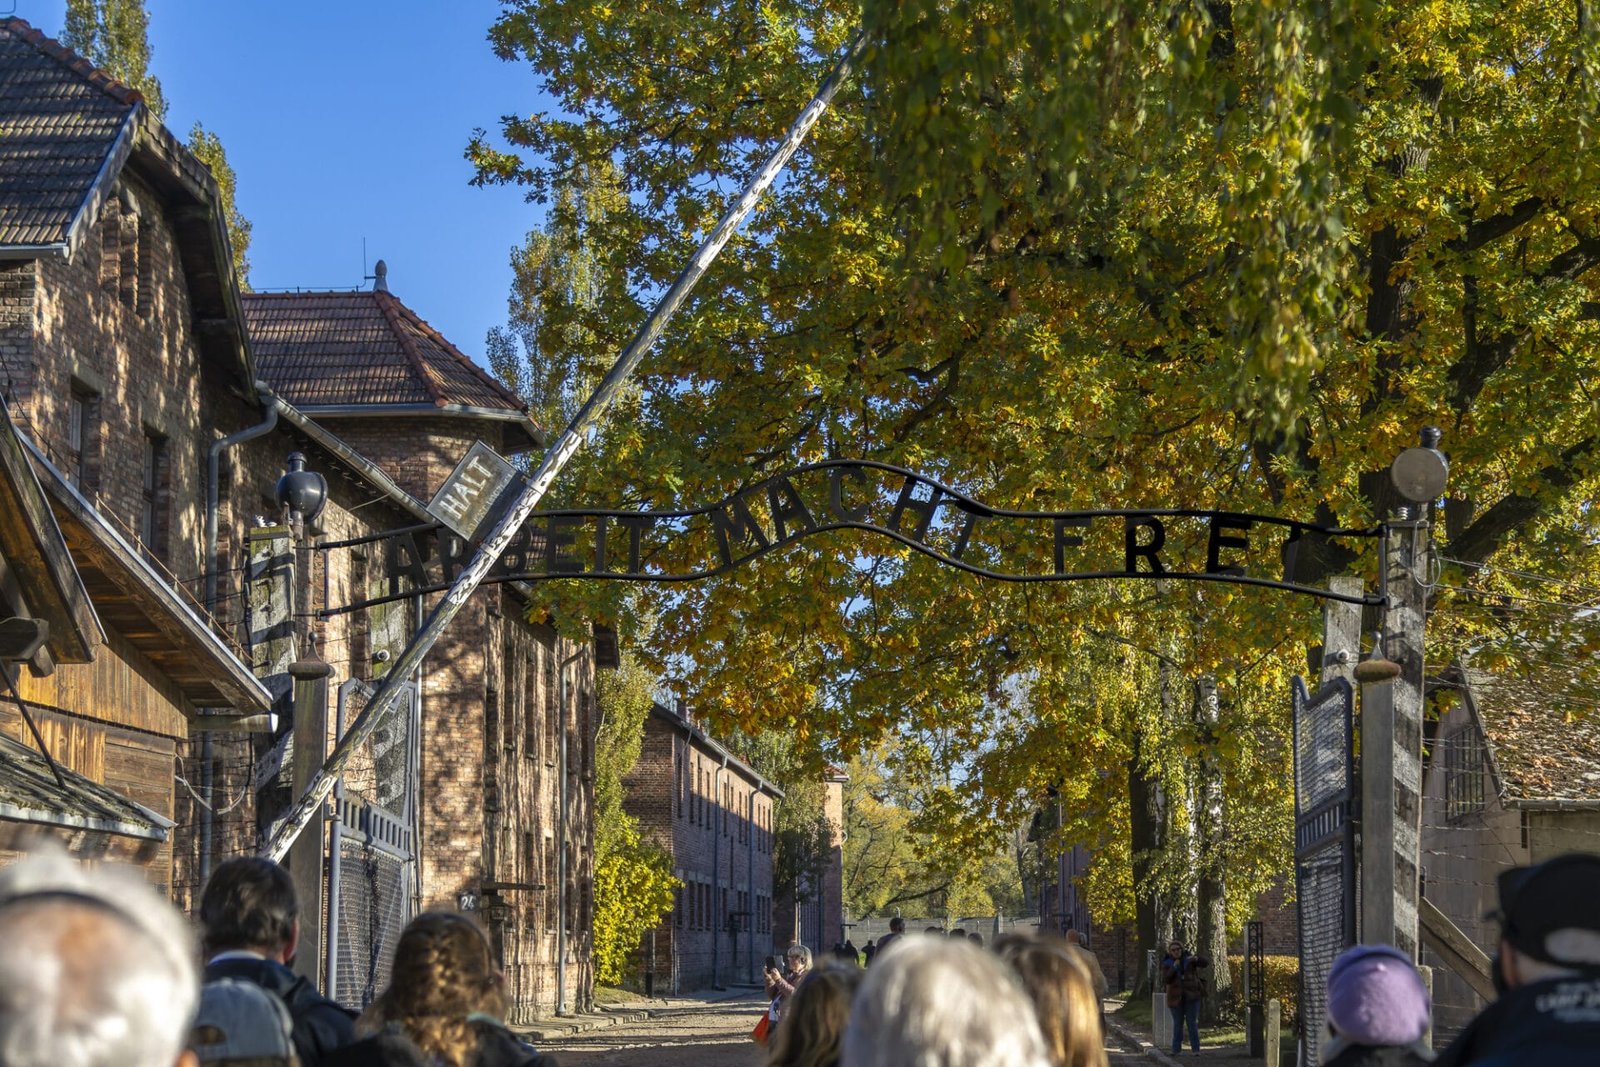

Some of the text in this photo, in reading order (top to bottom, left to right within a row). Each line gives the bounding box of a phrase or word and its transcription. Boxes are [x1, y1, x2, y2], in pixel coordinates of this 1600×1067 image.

[439, 455, 494, 519] HALT
[709, 464, 994, 566] MACHT
[1053, 516, 1303, 583] FREI
